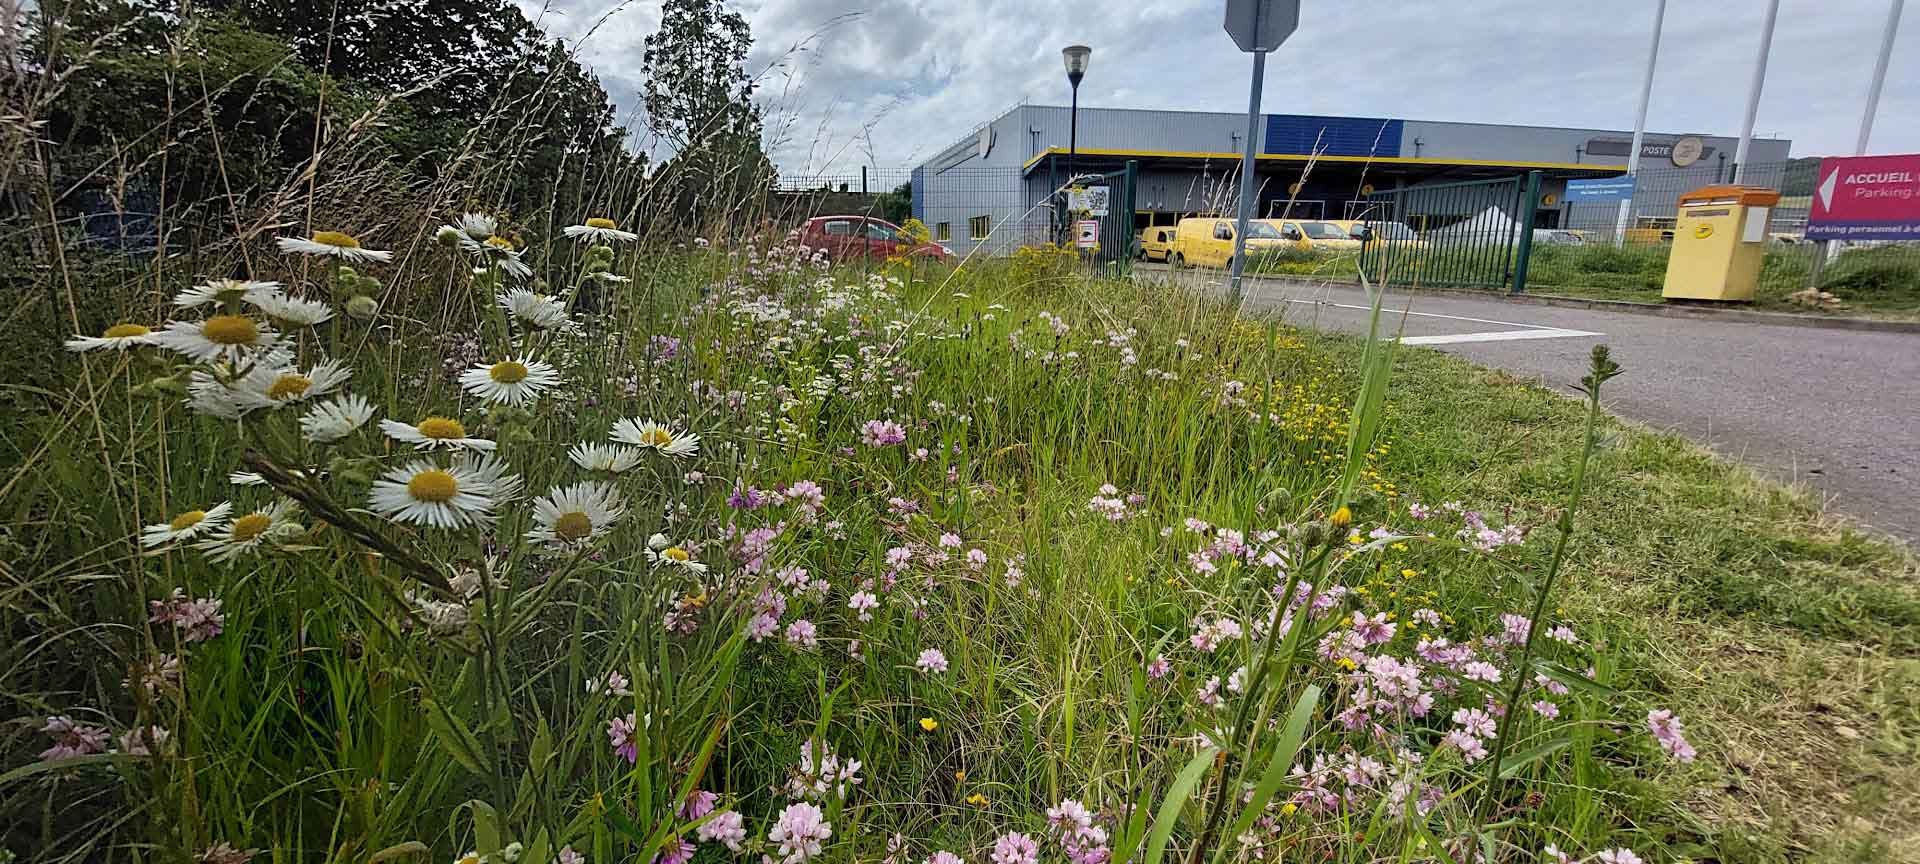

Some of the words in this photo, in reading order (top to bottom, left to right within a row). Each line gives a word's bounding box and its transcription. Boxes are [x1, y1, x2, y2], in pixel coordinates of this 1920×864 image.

[1643, 146, 1671, 155] POSTE
[1845, 172, 1912, 184] ACCUEIL
[1856, 187, 1912, 199] Parking
[1808, 225, 1846, 234] Parking
[1848, 225, 1901, 234] personnel
